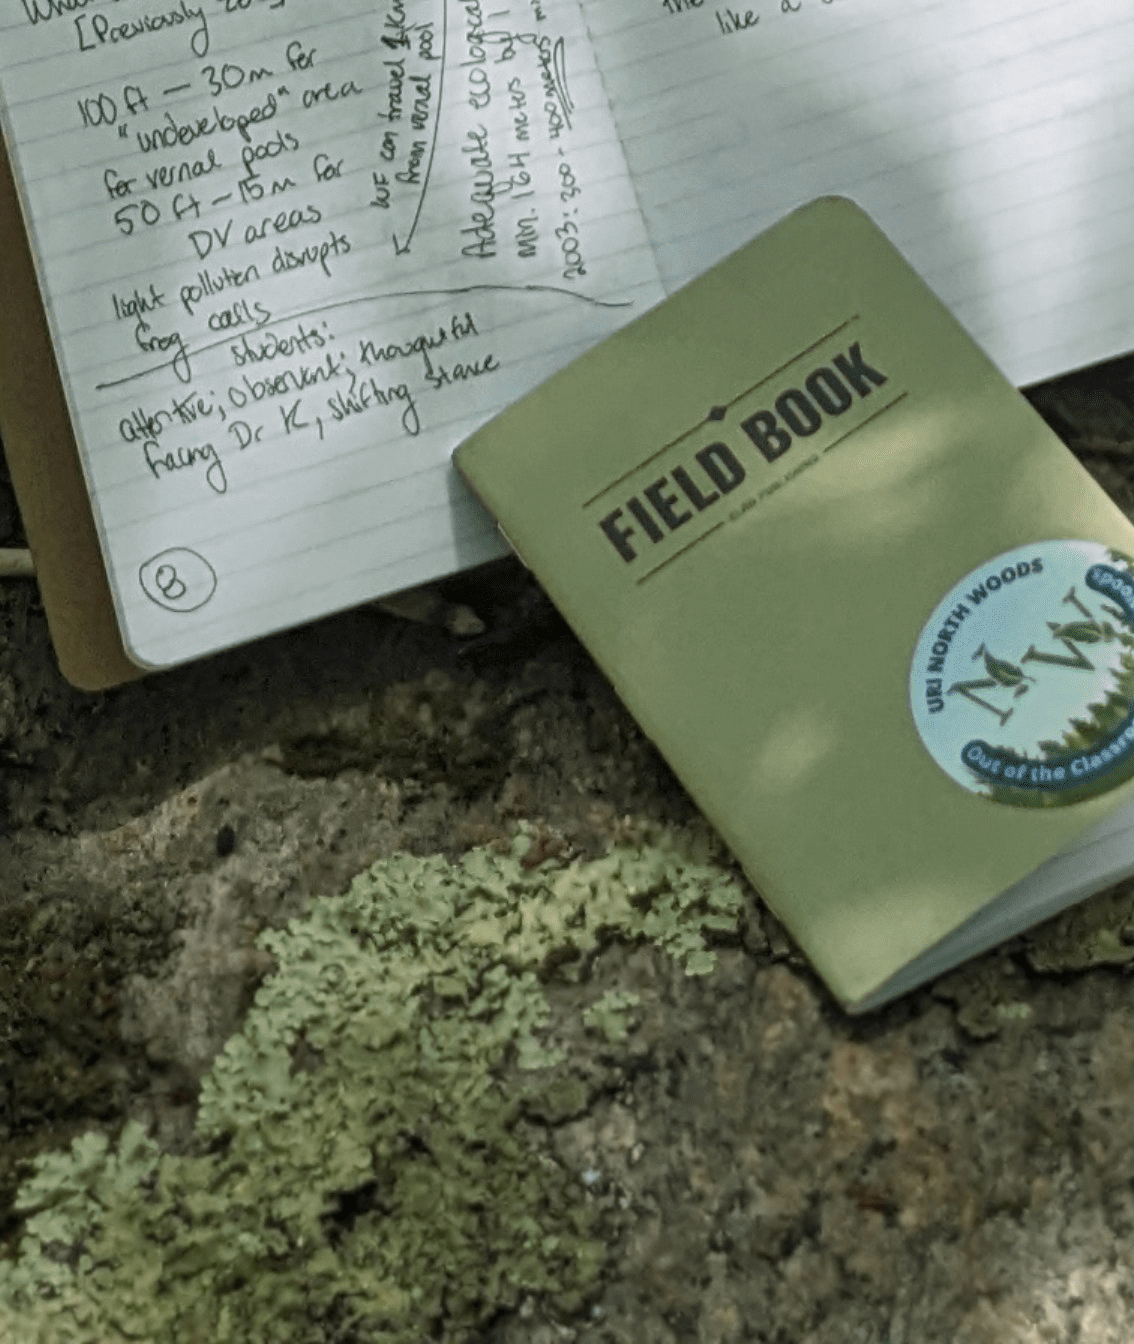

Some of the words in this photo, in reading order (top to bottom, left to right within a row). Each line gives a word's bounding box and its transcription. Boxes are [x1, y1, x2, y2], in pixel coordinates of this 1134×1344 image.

[414, 21, 442, 61] pool
[715, 9, 760, 35] like
[77, 93, 117, 127] 100
[124, 85, 149, 114] ft
[286, 40, 317, 71] for
[302, 80, 363, 109] area
[378, 57, 406, 122] travel
[408, 74, 432, 130] vernal
[507, 77, 531, 141] meters
[104, 169, 137, 200] for
[146, 148, 222, 191] vernal
[242, 130, 299, 175] pools
[380, 130, 399, 161] can
[395, 140, 428, 185] from
[114, 199, 161, 236] 50
[172, 193, 201, 220] ft
[313, 153, 345, 182] for
[507, 152, 535, 199] 164
[558, 162, 581, 202] 300
[188, 219, 233, 260] DV
[244, 204, 322, 244] areas
[112, 284, 166, 332] light
[180, 265, 261, 316] pollution
[272, 230, 352, 278] disrupts
[135, 322, 192, 384] frog
[208, 299, 272, 331] calls
[143, 440, 228, 493] facing
[228, 421, 263, 451] Dr
[327, 378, 420, 436] shifting
[425, 354, 500, 389] stance
[598, 441, 747, 564] FIELD
[740, 340, 889, 464] BOOK
[155, 564, 187, 600] 8
[966, 557, 1043, 605] WOODS
[926, 602, 971, 673] NORTH
[925, 678, 944, 714] URI
[966, 745, 1001, 774] Out
[1003, 762, 1028, 781] of
[1031, 763, 1065, 783] the
